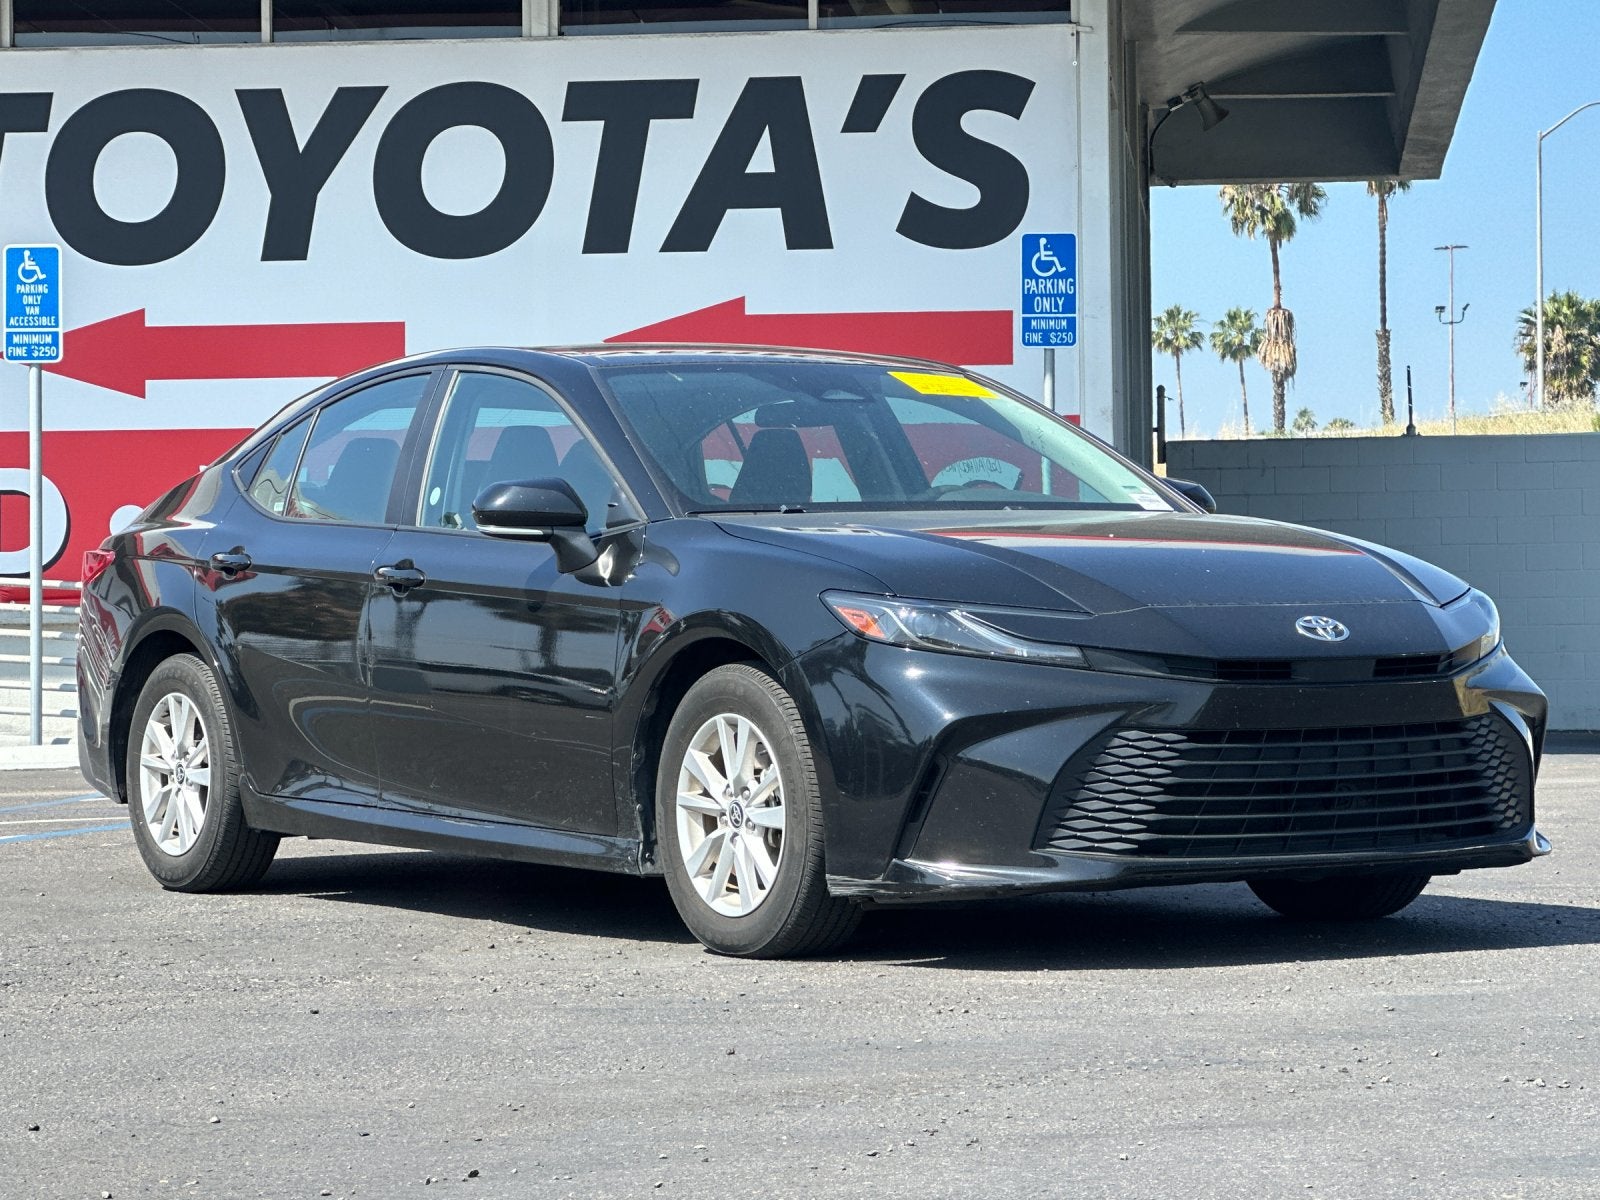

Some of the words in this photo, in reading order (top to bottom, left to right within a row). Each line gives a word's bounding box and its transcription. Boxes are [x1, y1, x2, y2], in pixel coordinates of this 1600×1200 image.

[16, 284, 48, 294] PARKING
[1024, 278, 1074, 294] PARKING
[22, 295, 42, 305] ONLY
[1034, 296, 1064, 313] ONLY
[25, 306, 40, 315] VAN
[9, 316, 55, 326] ACCESSIBLE
[1031, 319, 1067, 330] MINIMUM
[12, 334, 52, 345] MINIMUM
[1025, 332, 1043, 344] FINE
[1049, 331, 1073, 344] $250
[8, 346, 28, 357] FINE
[32, 346, 57, 358] $250
